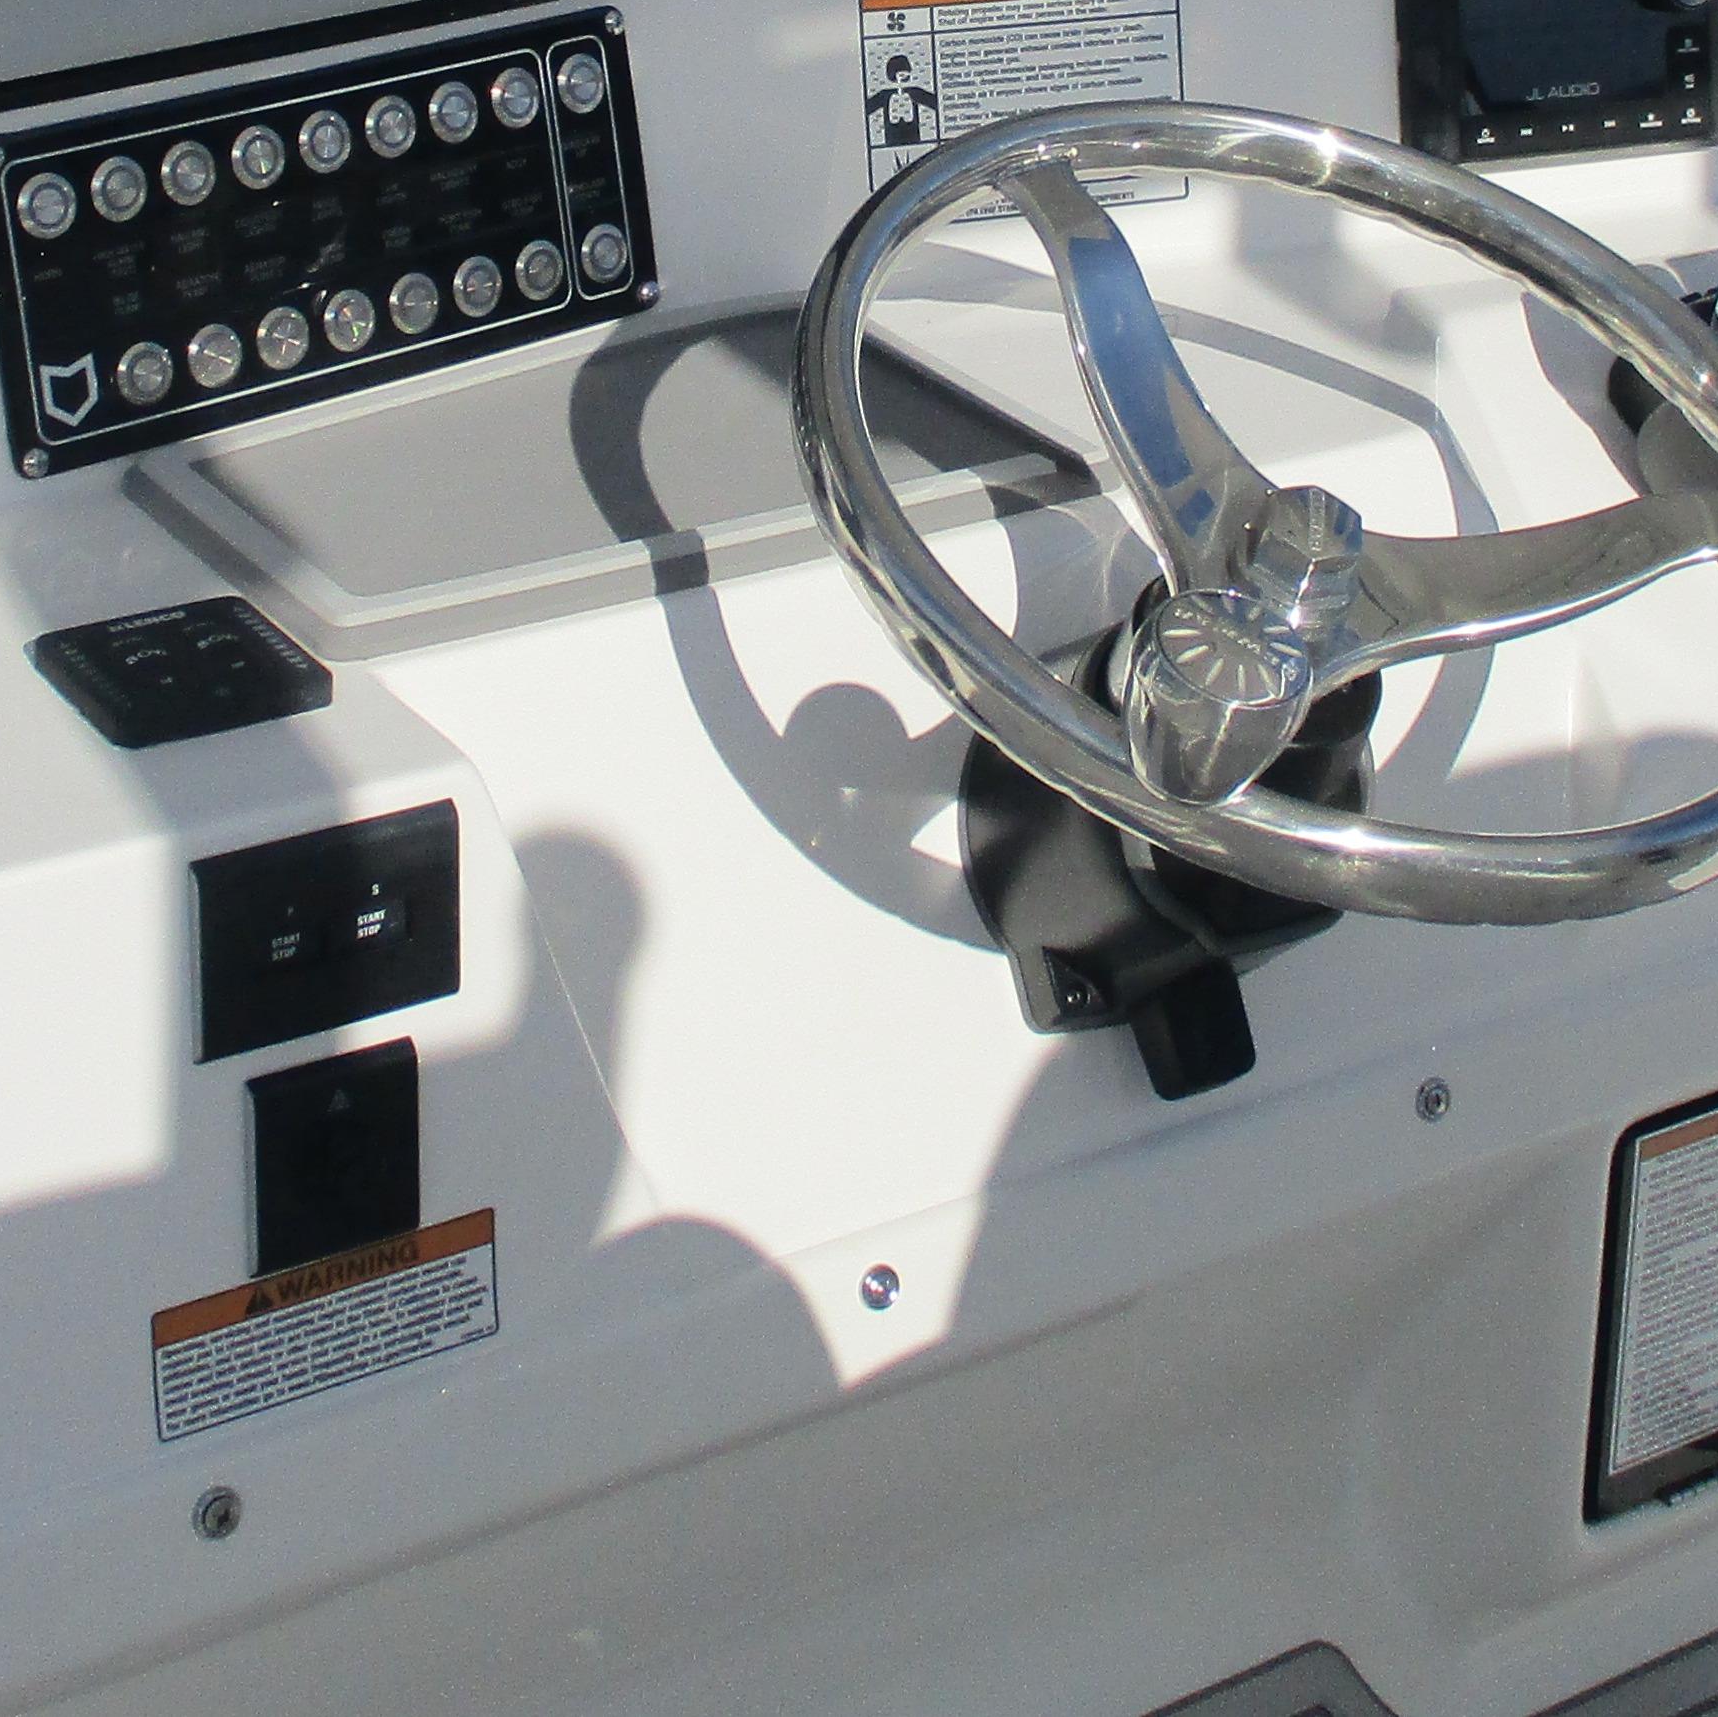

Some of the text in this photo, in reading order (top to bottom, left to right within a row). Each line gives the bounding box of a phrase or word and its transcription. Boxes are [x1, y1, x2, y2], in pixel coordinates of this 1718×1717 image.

[1525, 81, 1600, 102] JL AUDIO
[371, 883, 380, 896] S
[357, 908, 387, 927] START
[357, 923, 382, 940] STOP
[275, 1239, 420, 1301] WARNING
